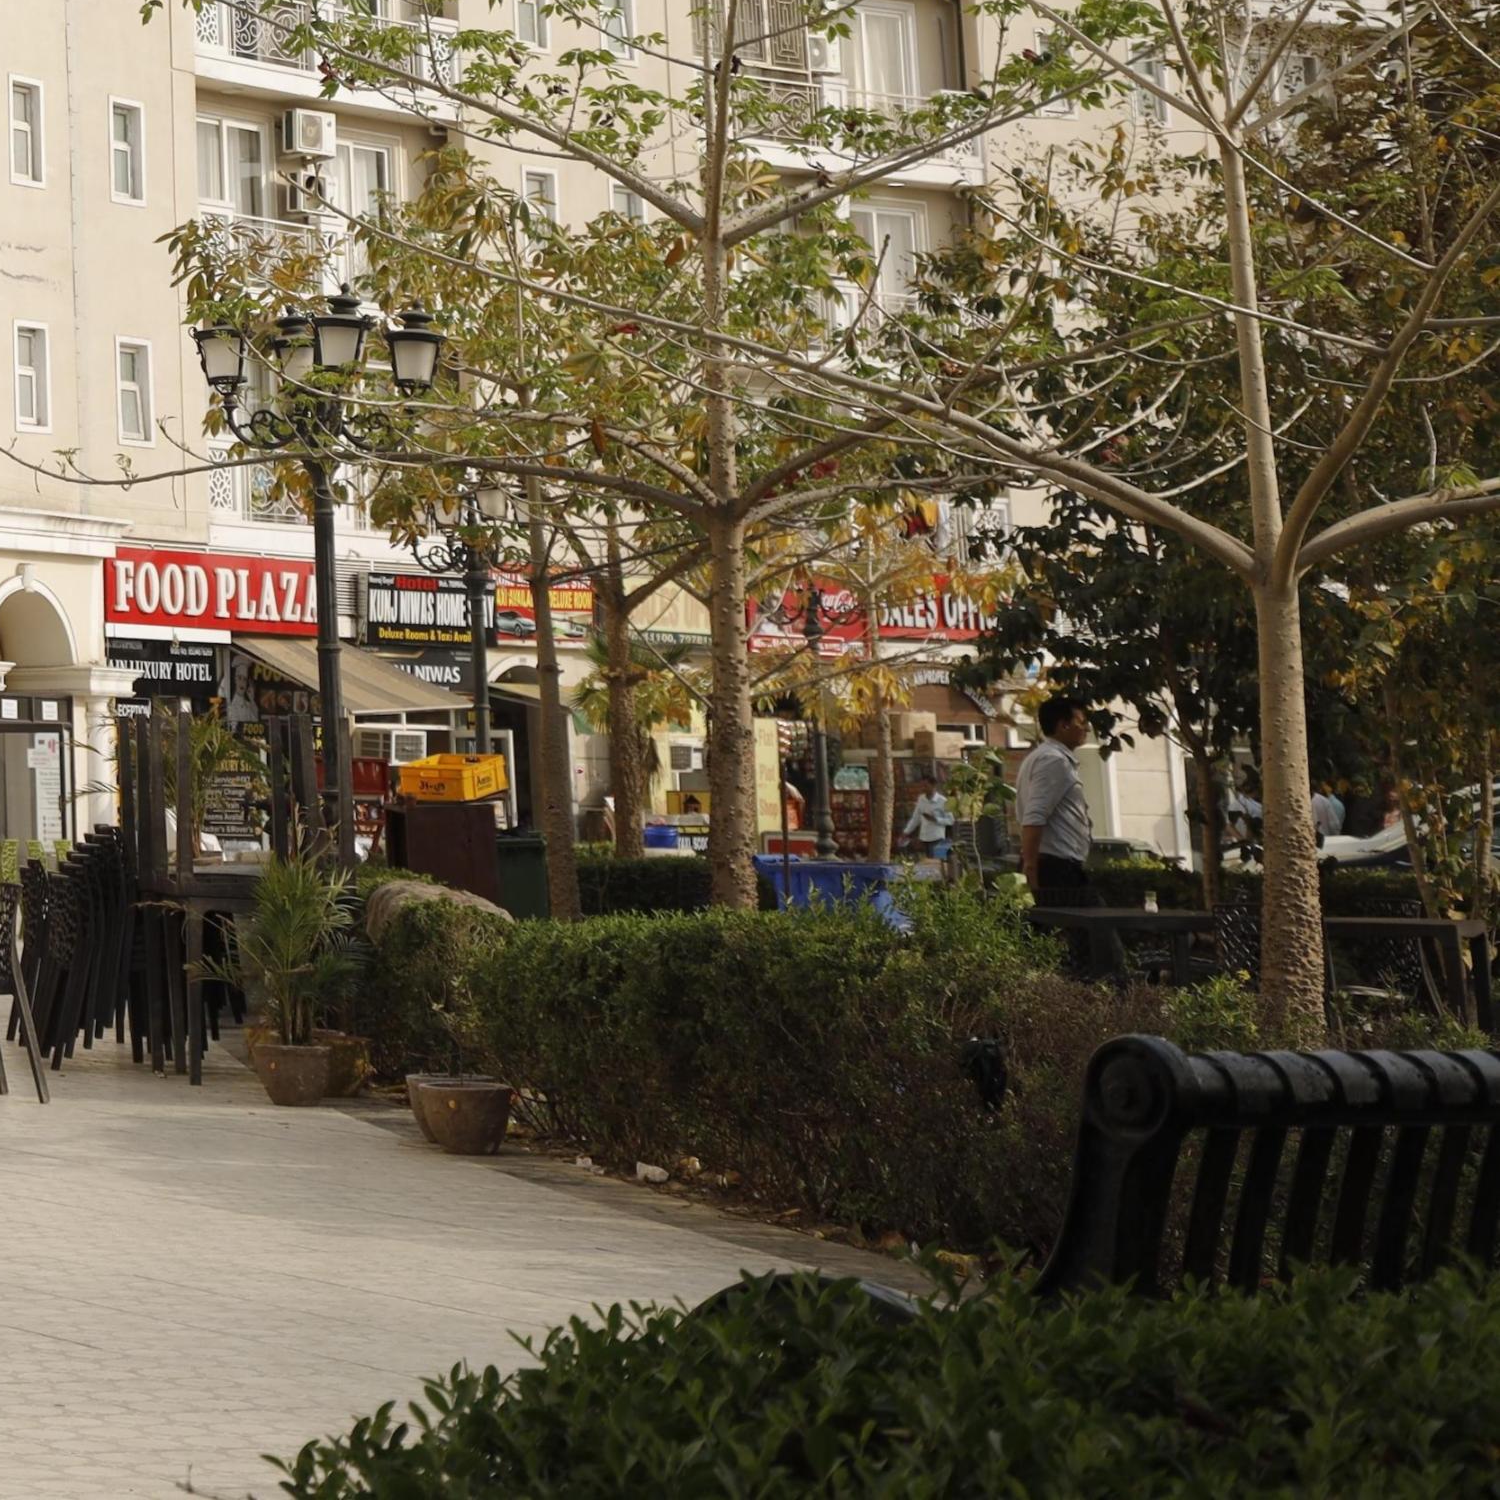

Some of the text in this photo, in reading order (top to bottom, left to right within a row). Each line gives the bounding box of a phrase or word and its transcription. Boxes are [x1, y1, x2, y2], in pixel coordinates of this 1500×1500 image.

[113, 559, 209, 617] FOOD
[395, 573, 438, 591] Hotel
[369, 588, 467, 628] KUNJ NIWAS HOME
[879, 593, 938, 630] SALES
[378, 627, 404, 640] Deluxe
[405, 629, 428, 641] Rooms
[430, 630, 436, 641] &
[436, 630, 452, 642] Taxi
[175, 662, 213, 682] HOTEL
[415, 666, 462, 684] NIWAS
